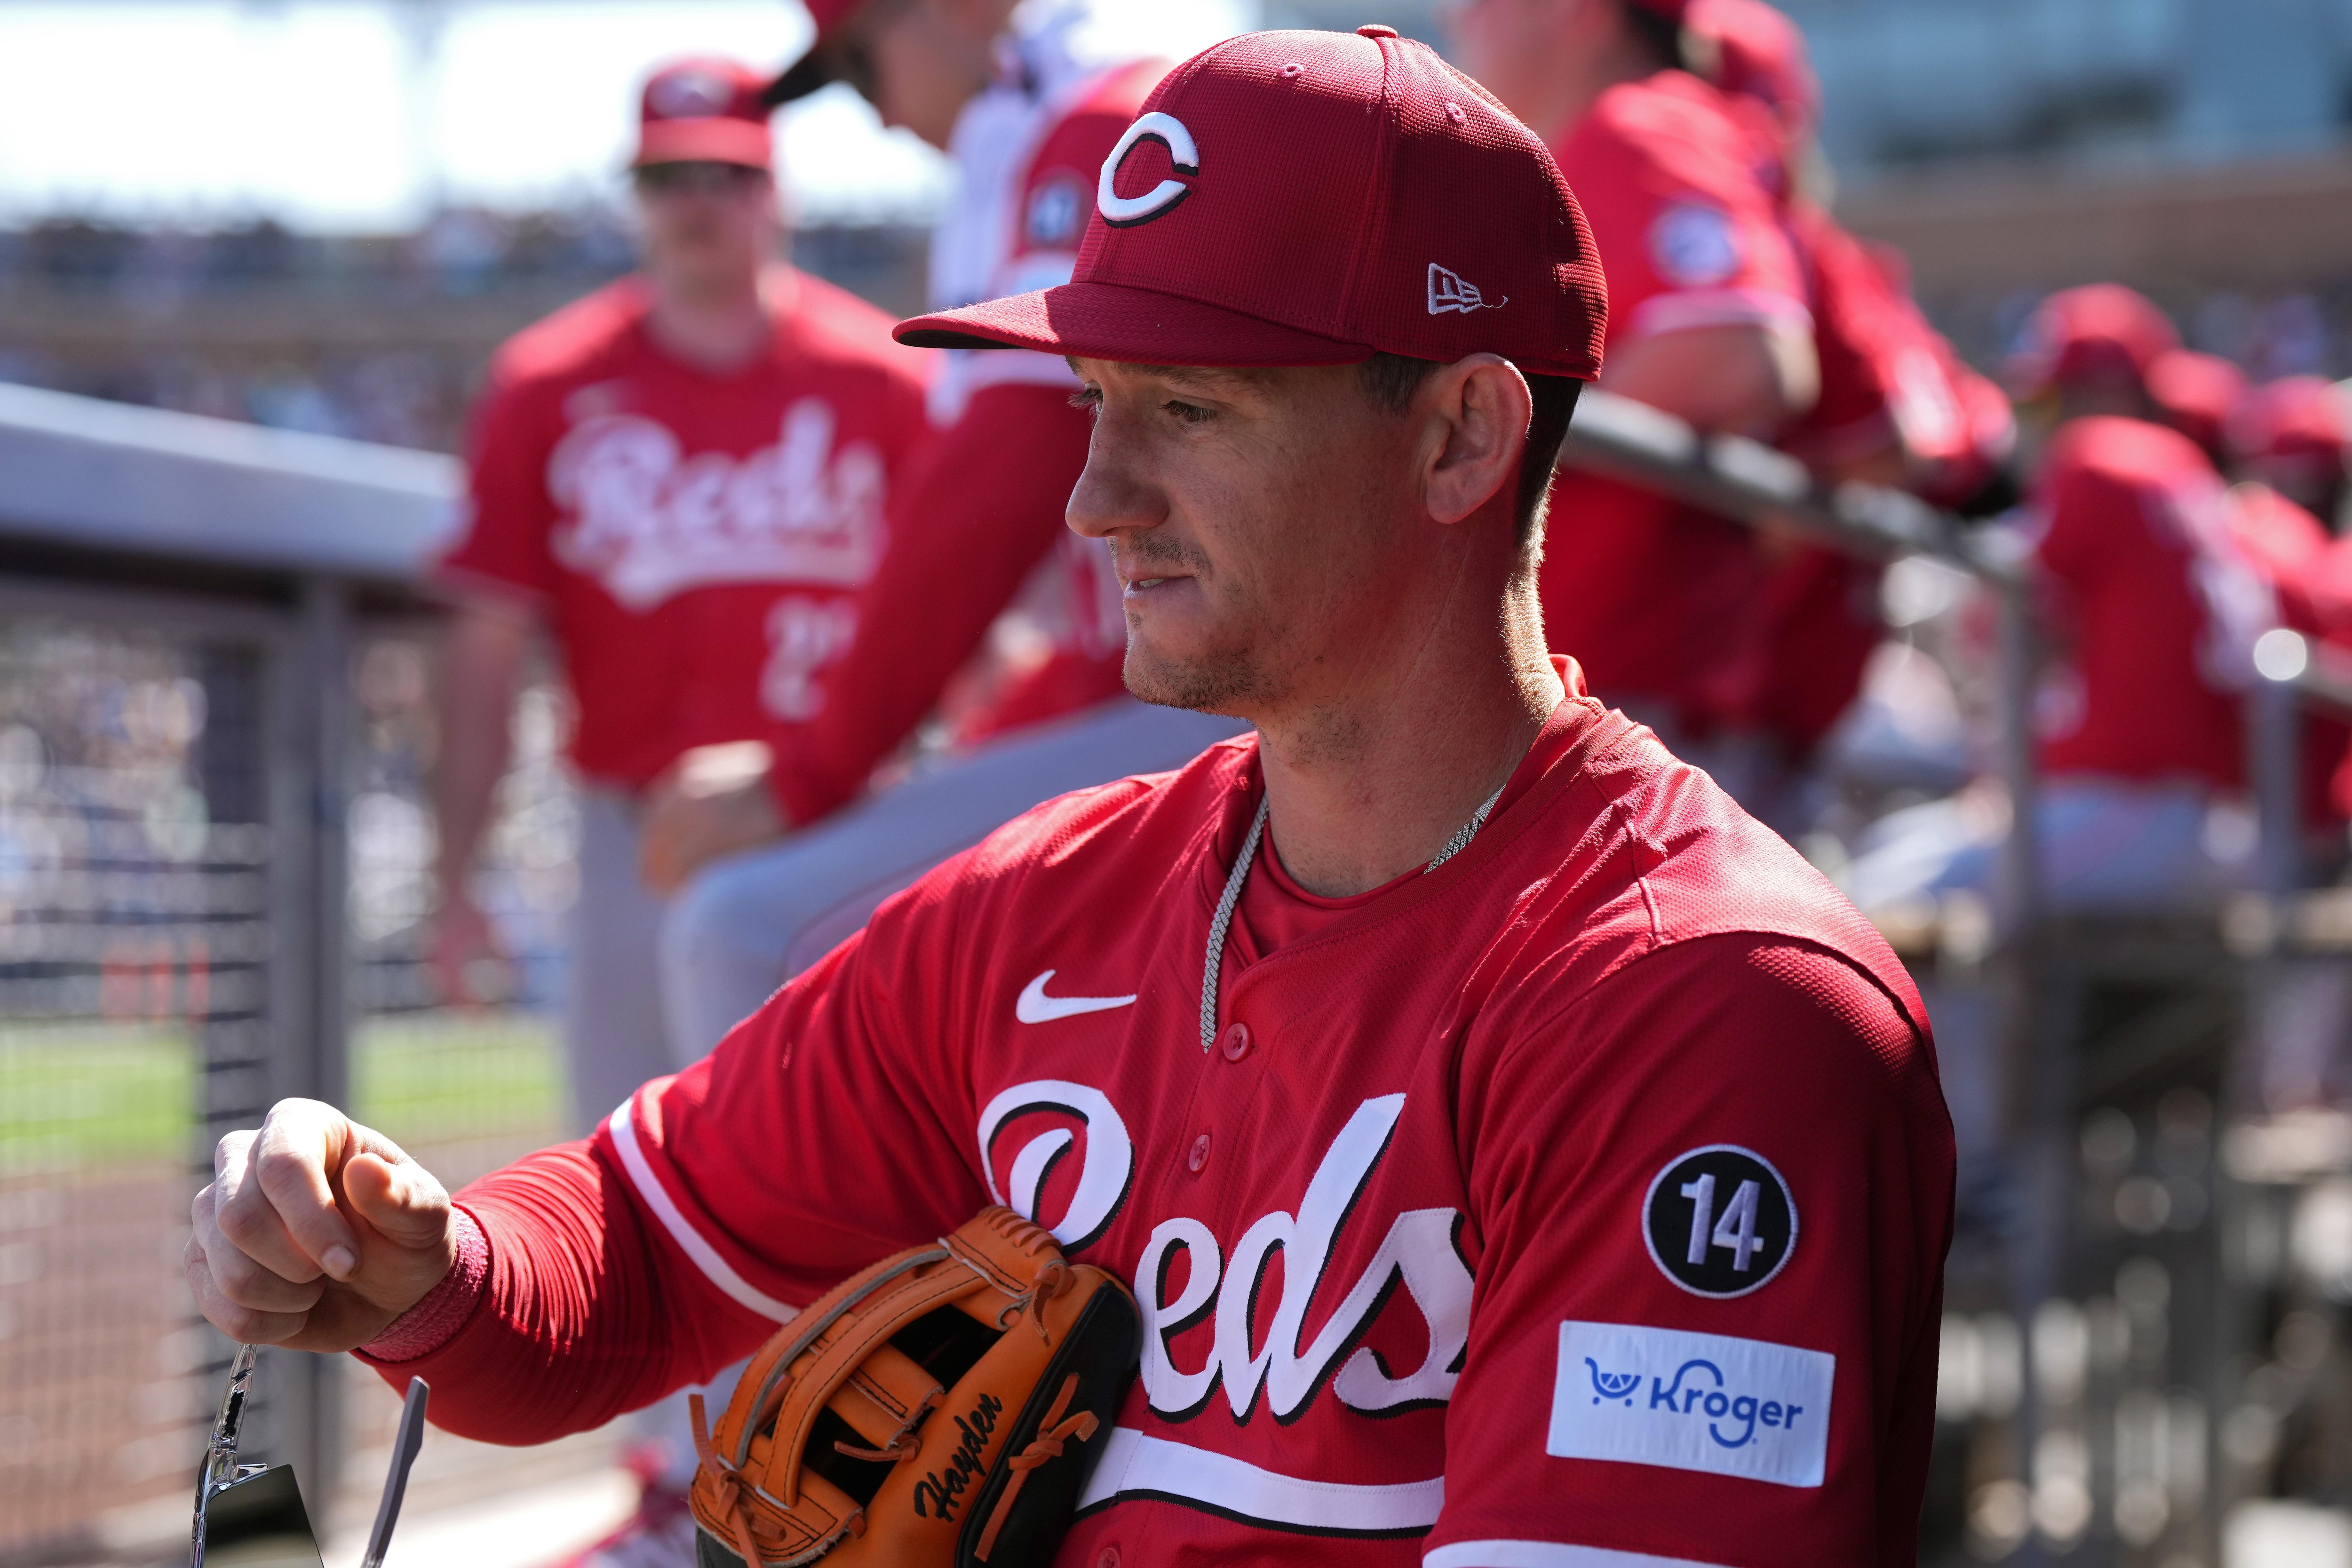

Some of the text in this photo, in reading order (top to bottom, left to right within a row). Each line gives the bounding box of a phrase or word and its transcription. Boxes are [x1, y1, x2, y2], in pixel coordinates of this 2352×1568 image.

[1097, 111, 1199, 229] C
[1681, 1173, 1764, 1272] 14
[914, 1393, 1003, 1523] Hayden
[1649, 1359, 1803, 1449] Kroger
